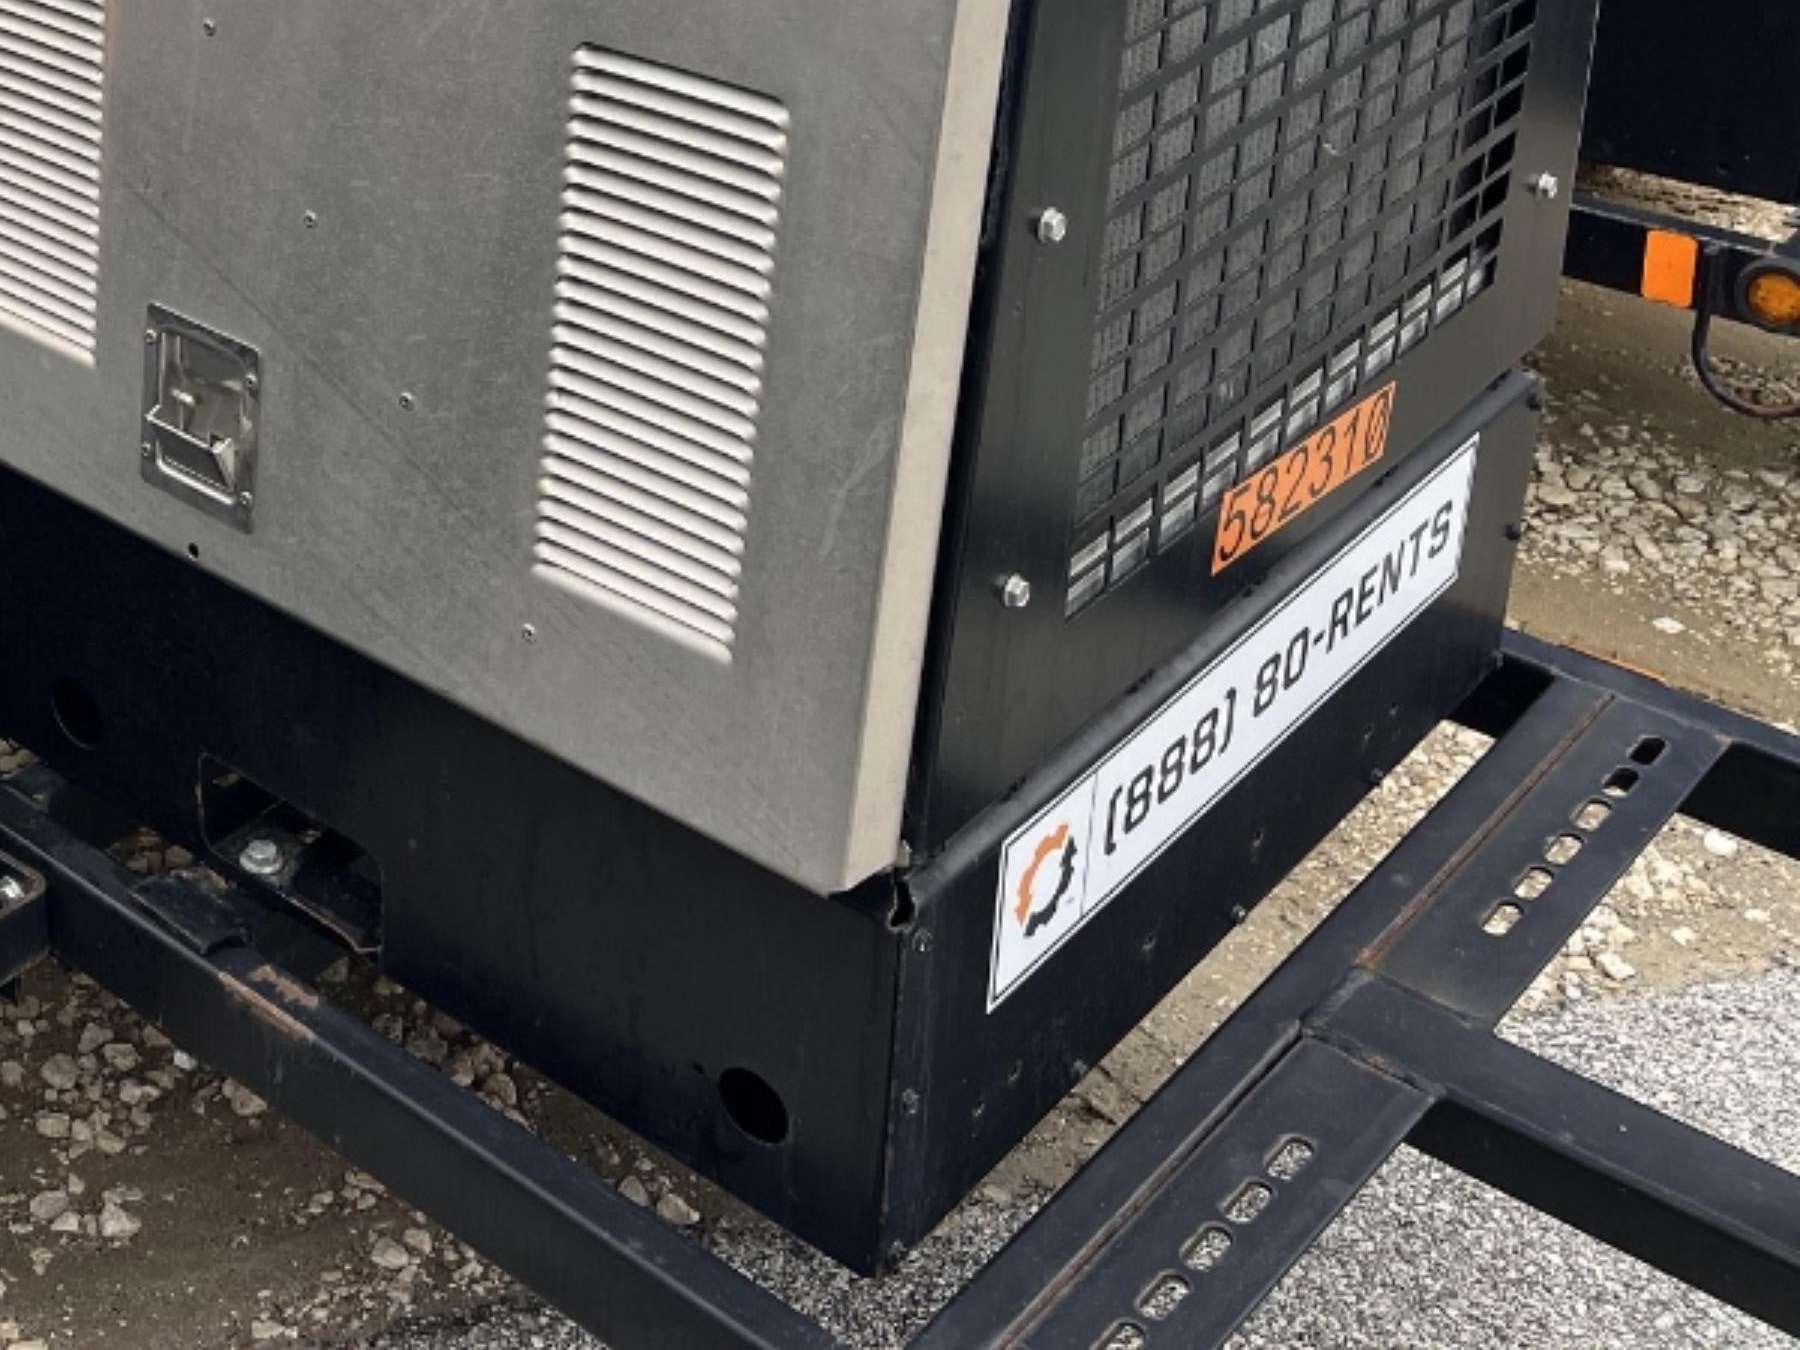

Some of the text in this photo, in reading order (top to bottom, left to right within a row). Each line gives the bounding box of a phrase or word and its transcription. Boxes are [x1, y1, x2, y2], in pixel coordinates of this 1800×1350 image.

[1220, 391, 1391, 561] 582310
[1104, 500, 1453, 855] (888) 80-RENTS
